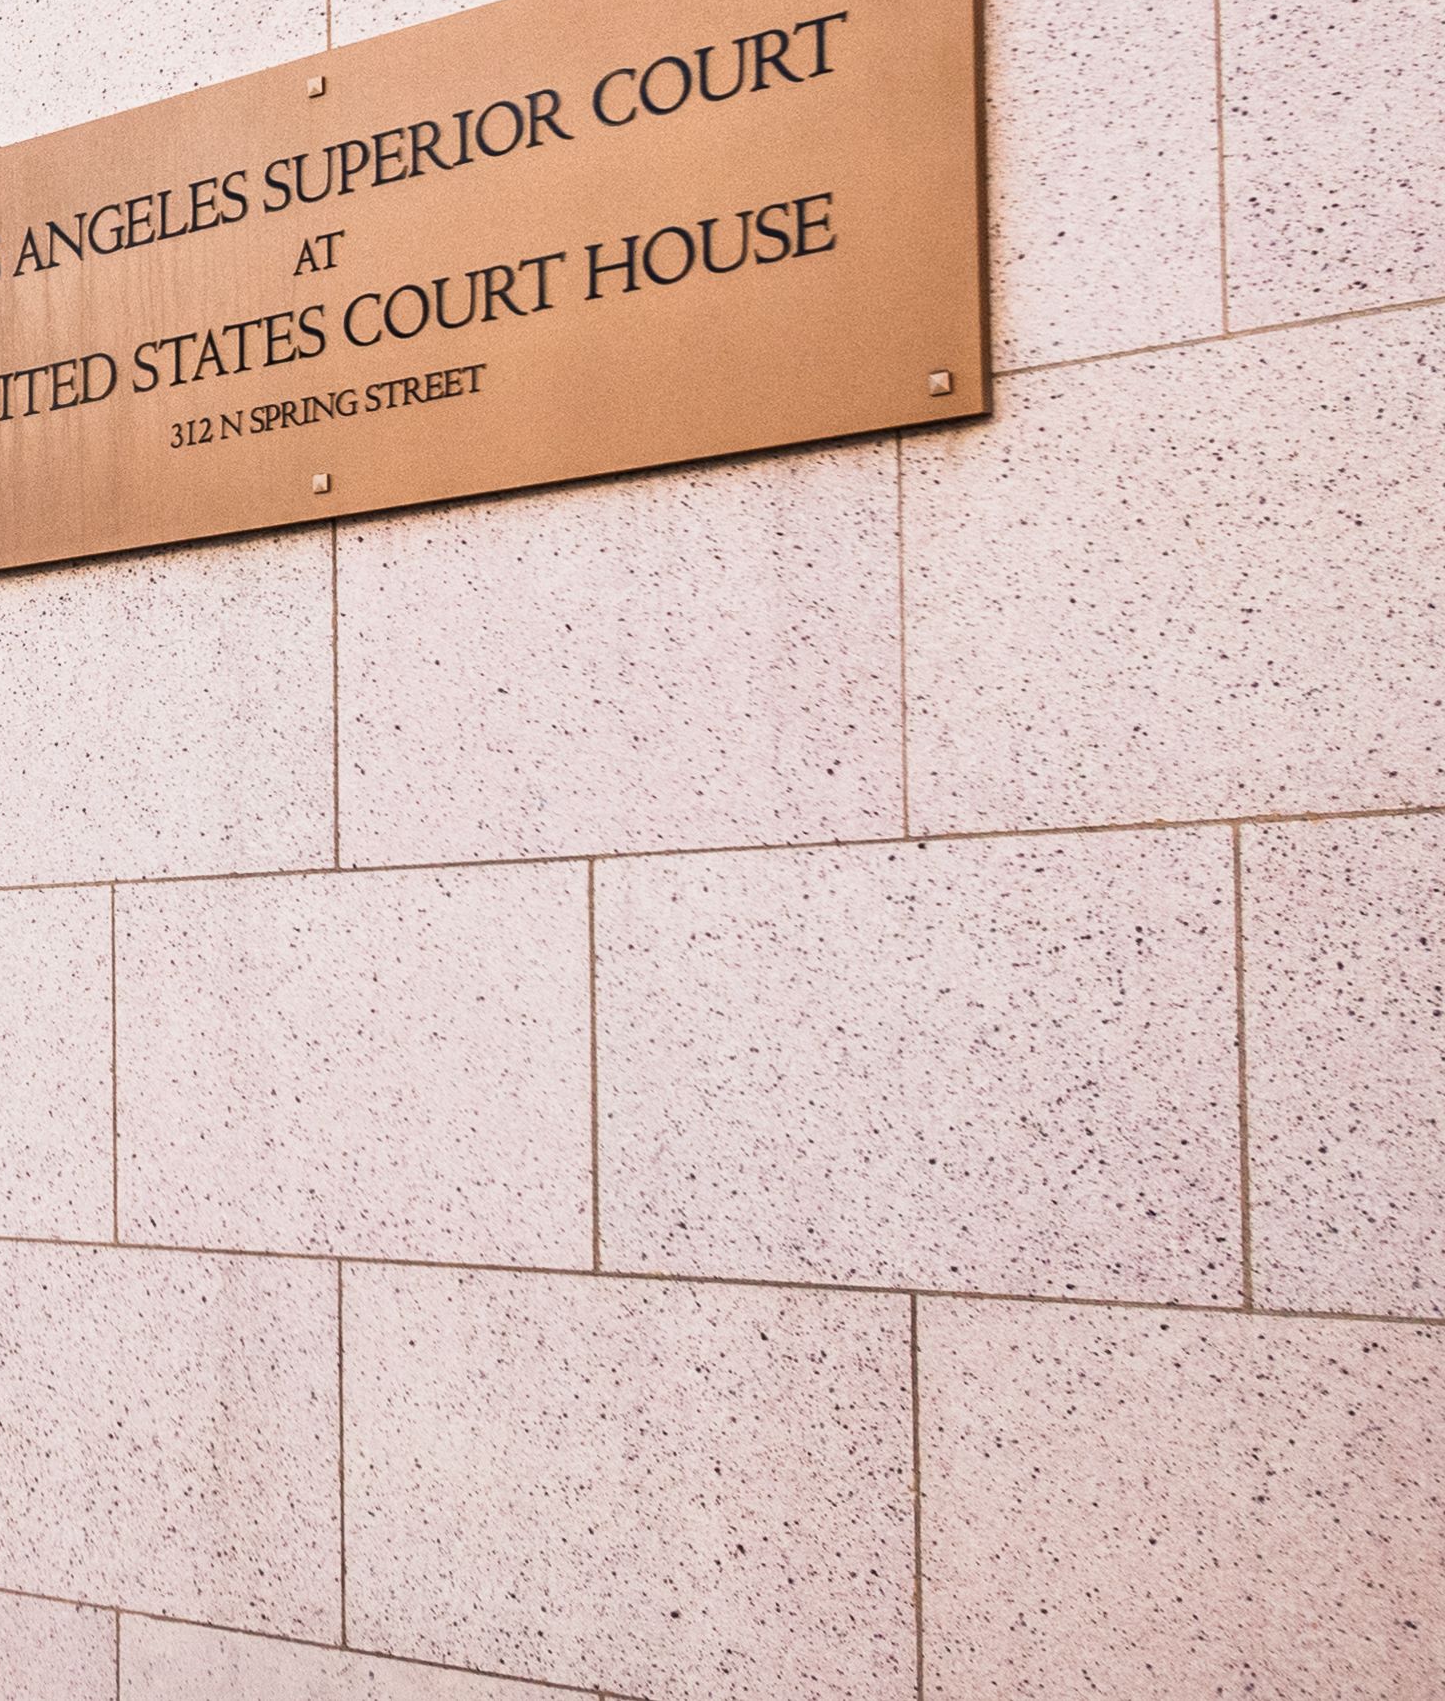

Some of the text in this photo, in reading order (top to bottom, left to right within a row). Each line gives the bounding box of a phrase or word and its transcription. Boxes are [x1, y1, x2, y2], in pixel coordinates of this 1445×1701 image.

[11, 168, 249, 278] ANGELES
[261, 87, 576, 214] SUPERIOR
[590, 9, 849, 128] COURT
[131, 303, 327, 394] STATES
[342, 250, 568, 348] COURT
[583, 191, 837, 302] HOUSE
[291, 228, 346, 278] AT
[169, 362, 488, 450] 312 N SPRING STREET
